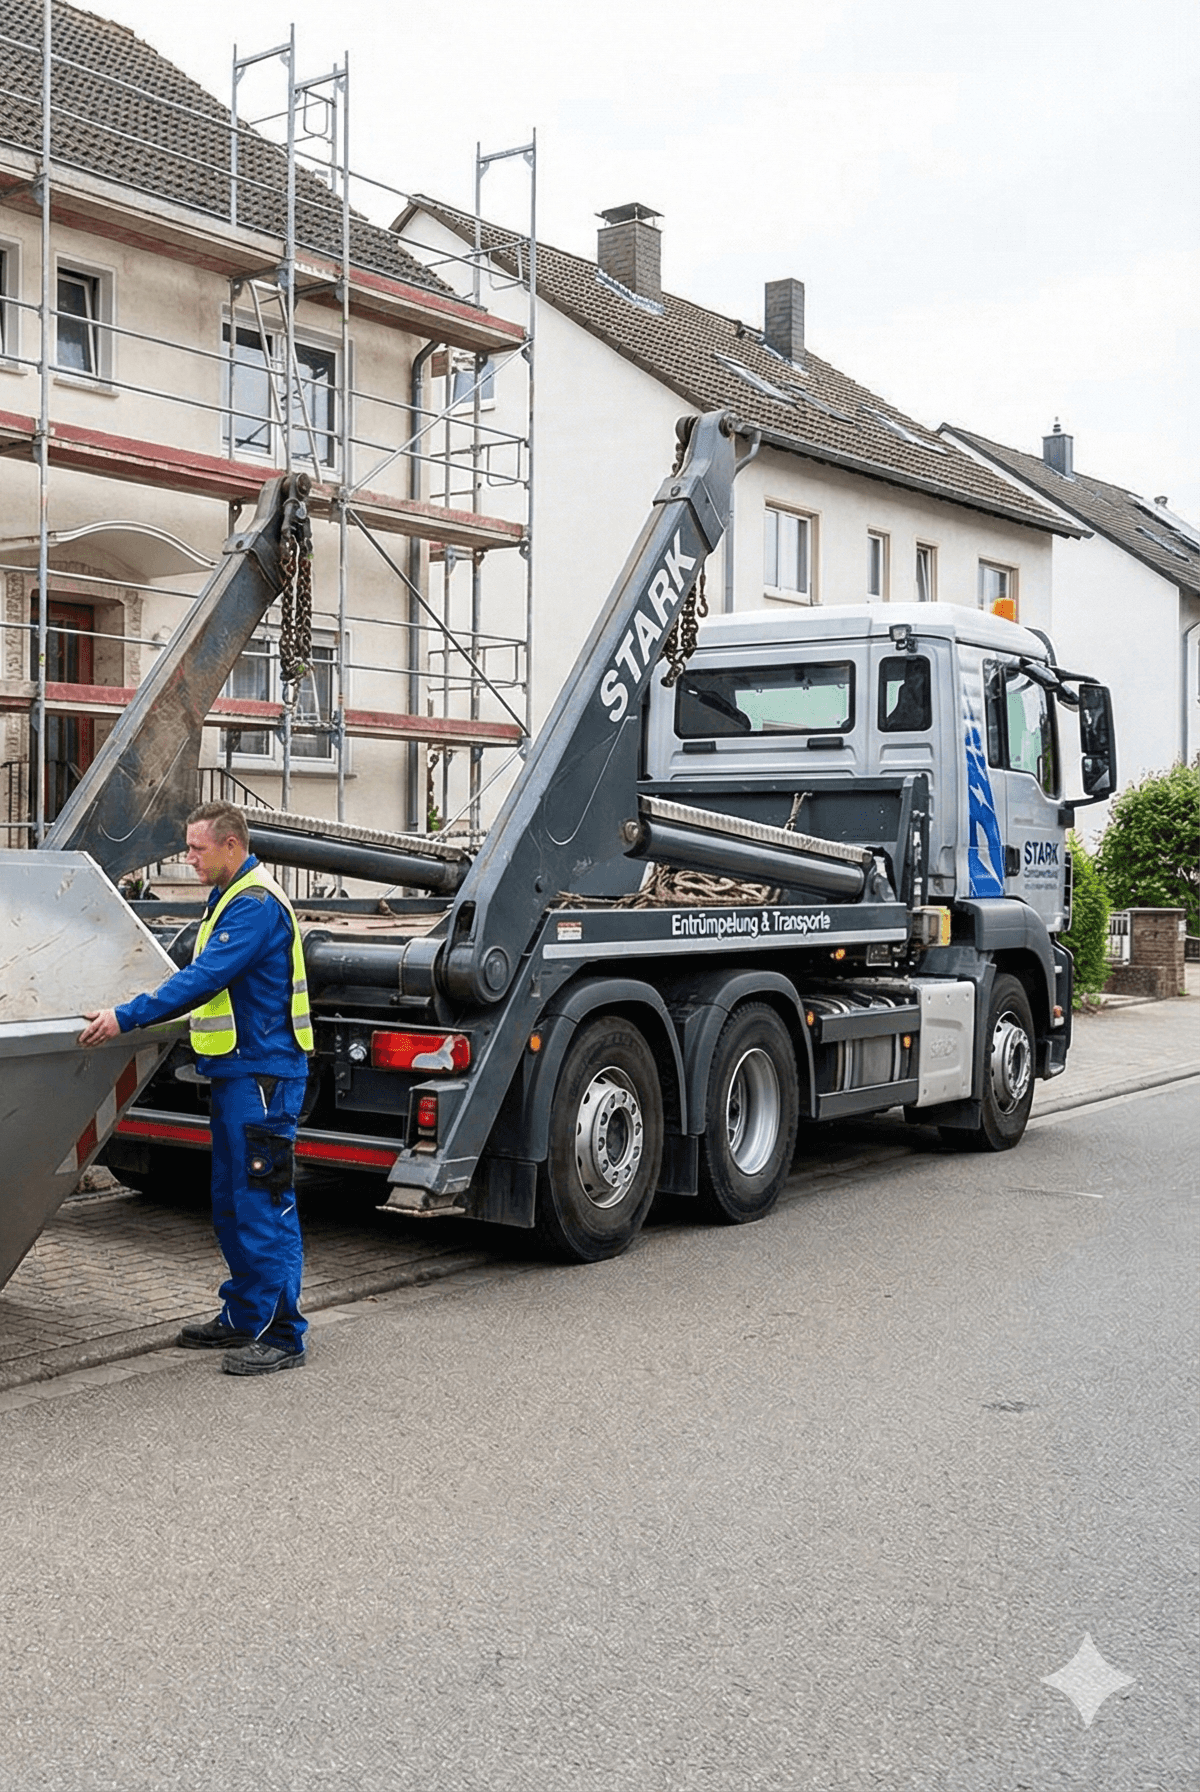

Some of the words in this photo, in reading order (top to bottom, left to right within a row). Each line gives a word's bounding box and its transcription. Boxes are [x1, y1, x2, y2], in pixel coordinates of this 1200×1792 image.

[600, 528, 697, 722] STARK
[1024, 841, 1059, 865] STARK
[761, 911, 770, 932] &
